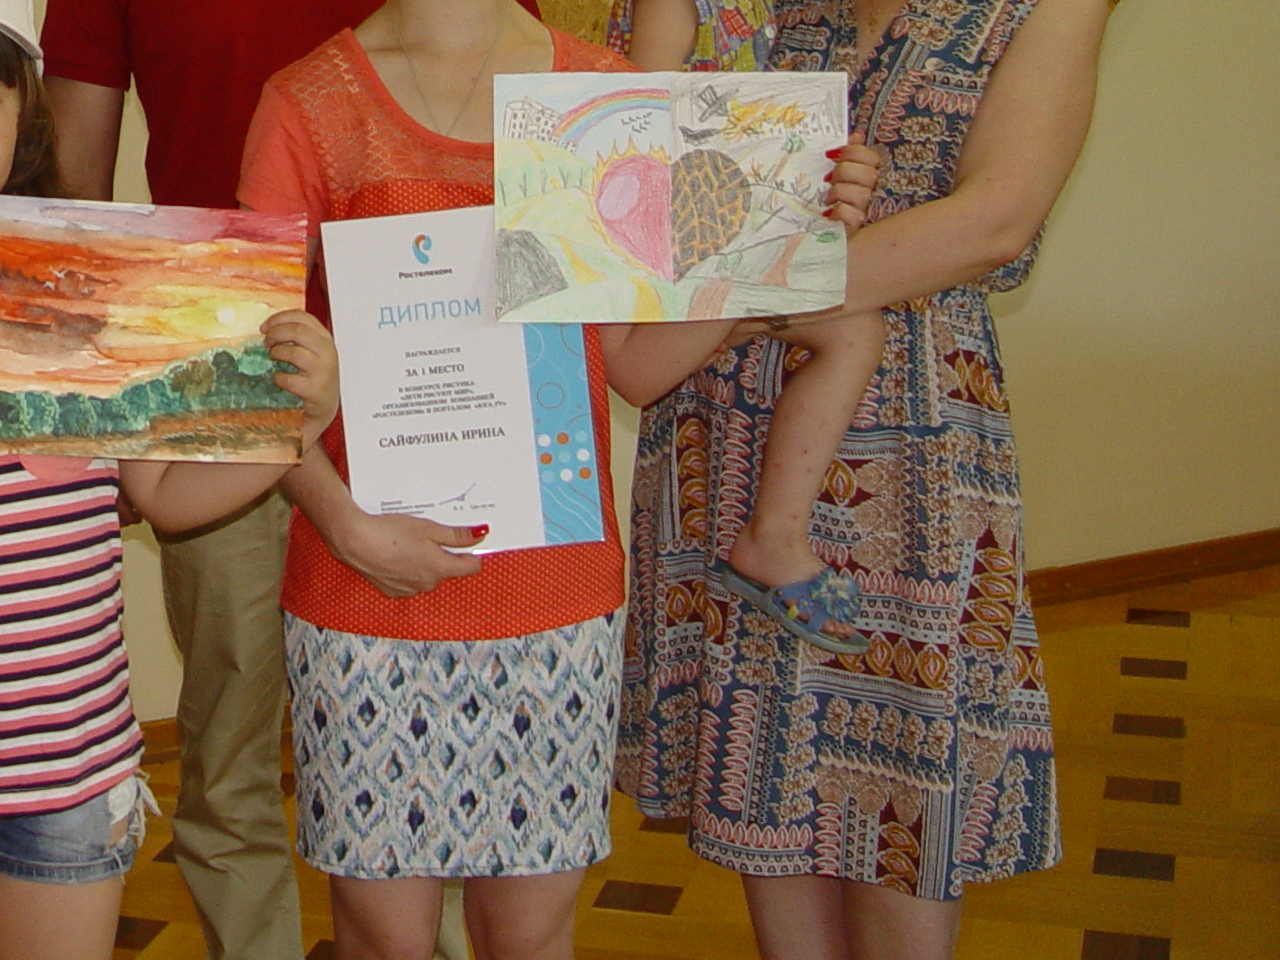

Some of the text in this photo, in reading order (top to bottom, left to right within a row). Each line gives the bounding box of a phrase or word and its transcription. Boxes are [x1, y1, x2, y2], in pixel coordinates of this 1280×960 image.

[398, 267, 453, 279] Ростелеком
[377, 296, 482, 329] ДИПЛОМ
[404, 368, 418, 377] ЗА
[428, 363, 464, 375] МЕСТО
[378, 426, 505, 448] САЙФУЛИНА ИРИНА
